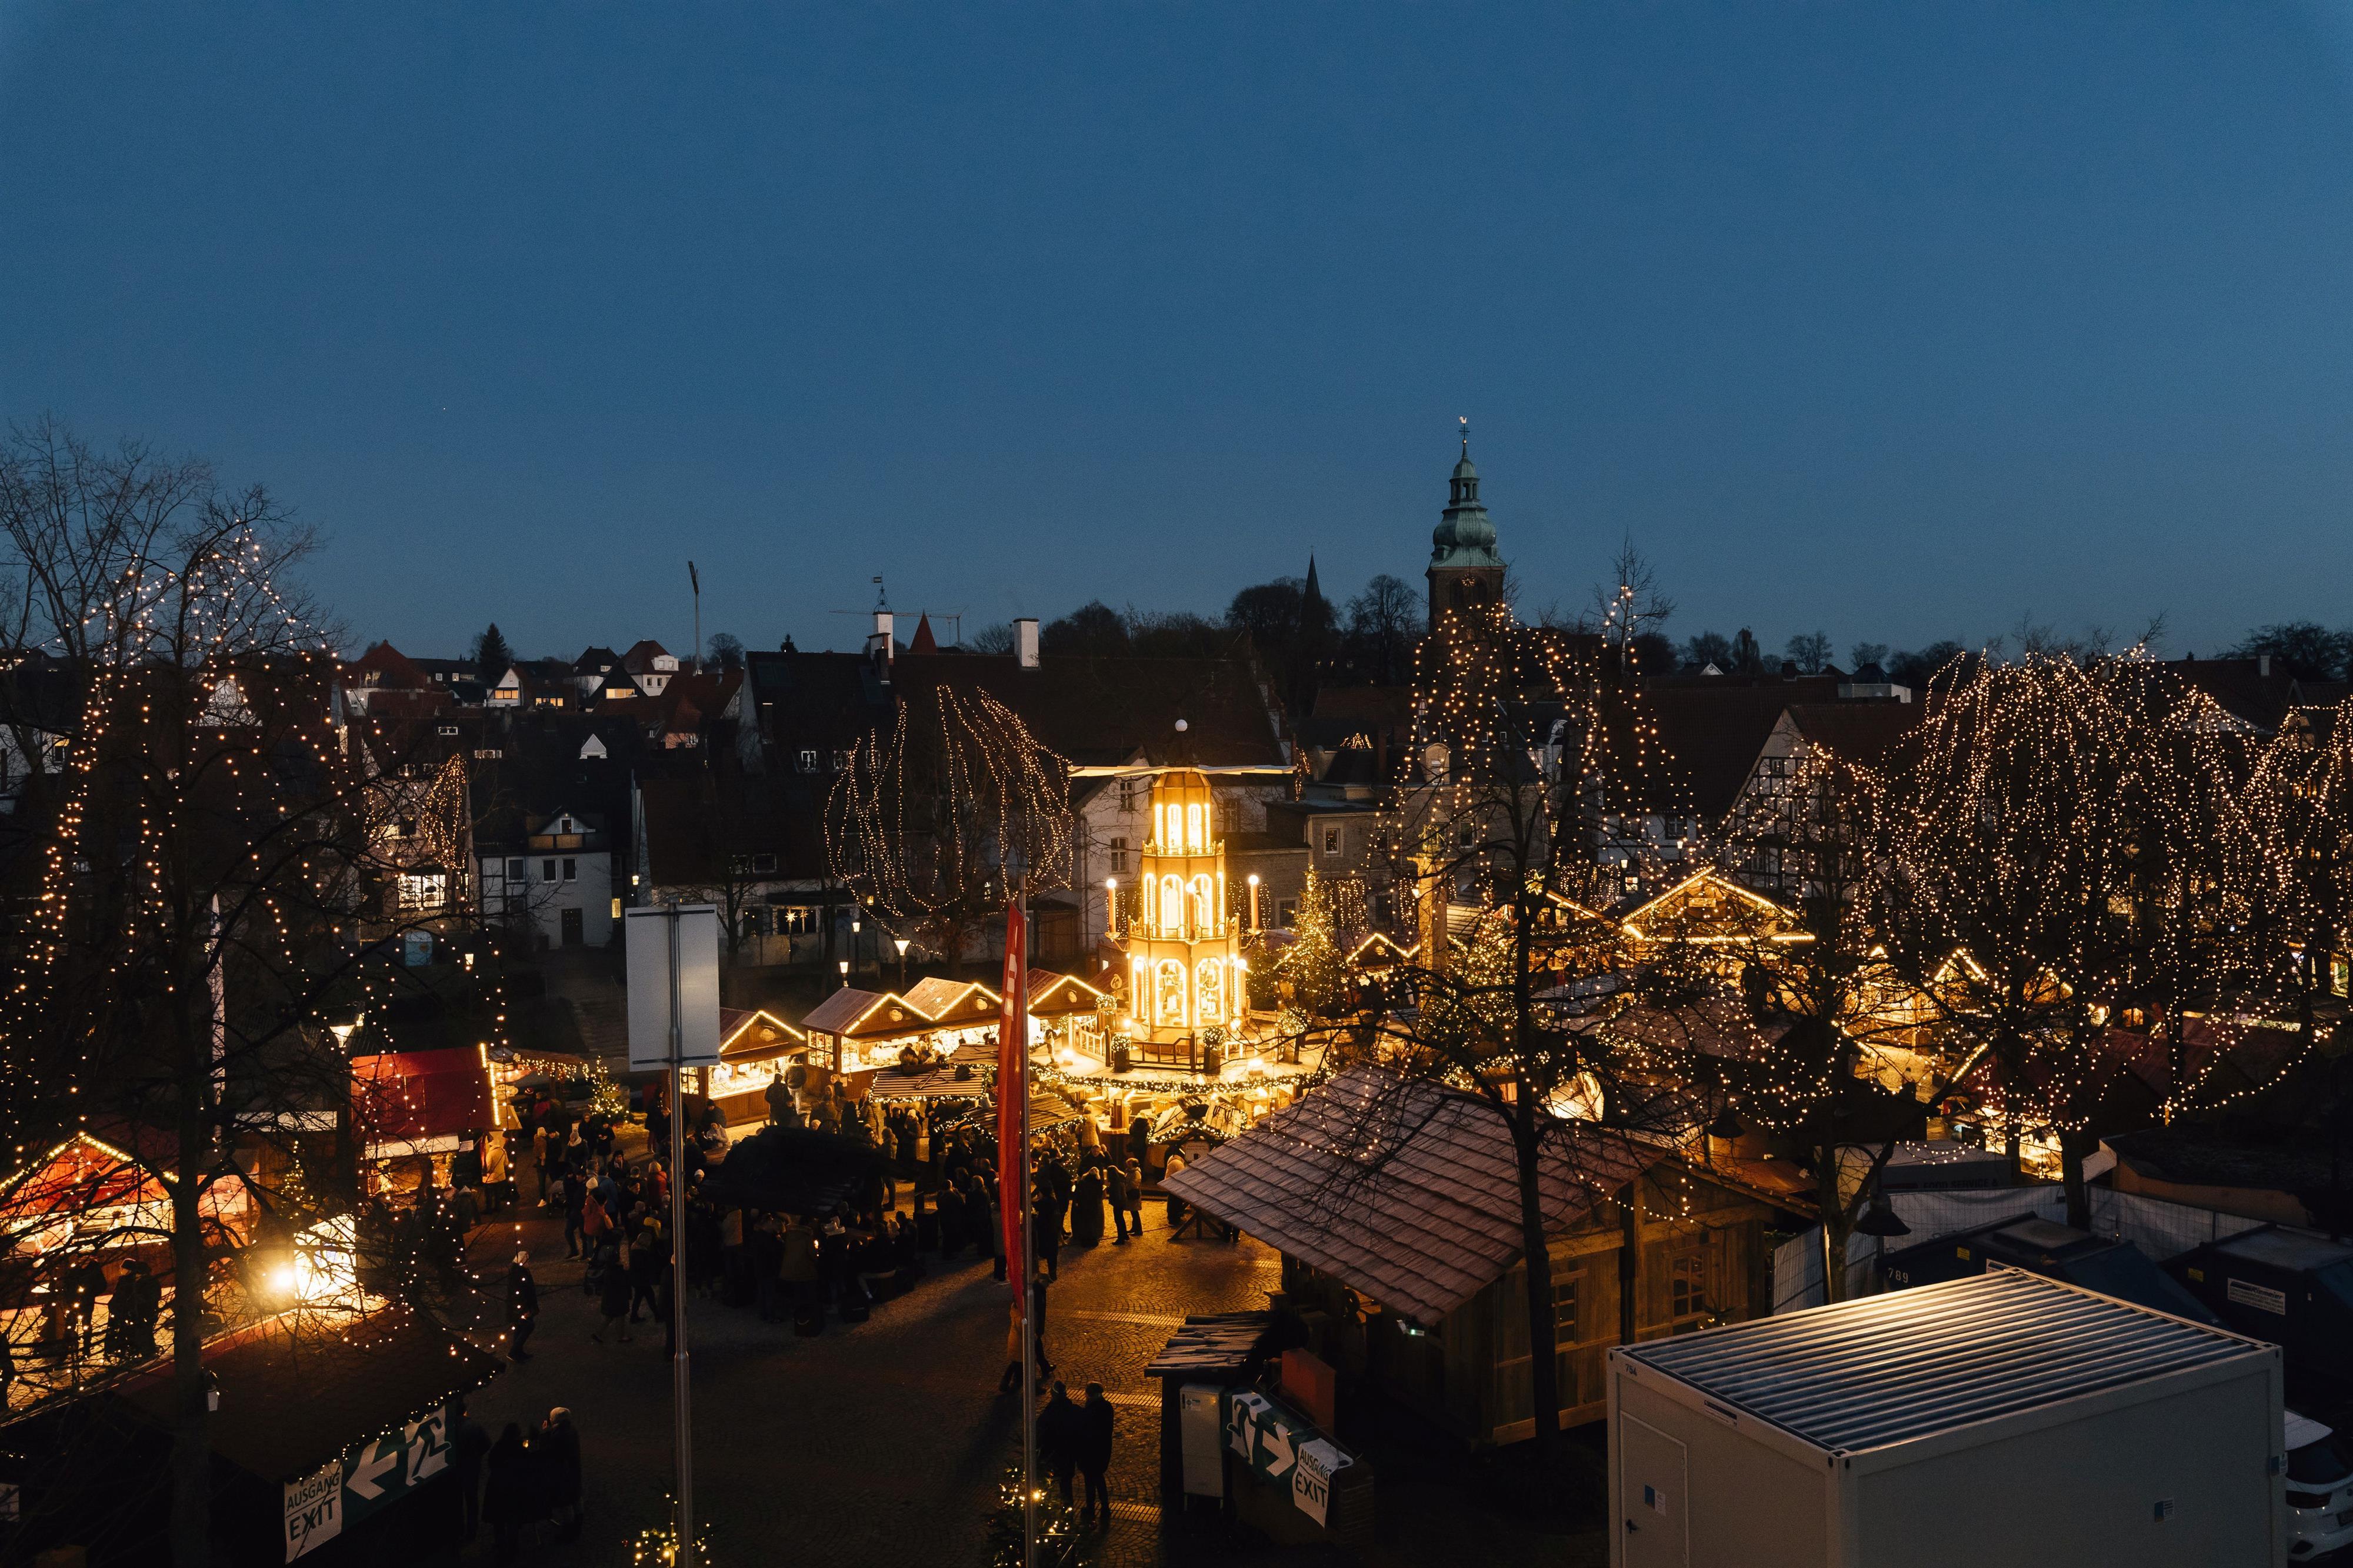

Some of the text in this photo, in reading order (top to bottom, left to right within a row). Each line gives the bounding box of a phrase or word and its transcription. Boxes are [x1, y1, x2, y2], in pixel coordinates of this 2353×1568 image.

[1951, 1178, 1989, 1188] SERVICE
[1992, 1178, 1998, 1186] &
[1888, 1267, 1908, 1283] 789
[1625, 1363, 1637, 1376] 754
[1299, 1449, 1331, 1481] AUSGANG
[287, 1473, 339, 1512] AUSGANG
[1295, 1472, 1327, 1508] EXIT
[290, 1496, 336, 1541] EXIT
